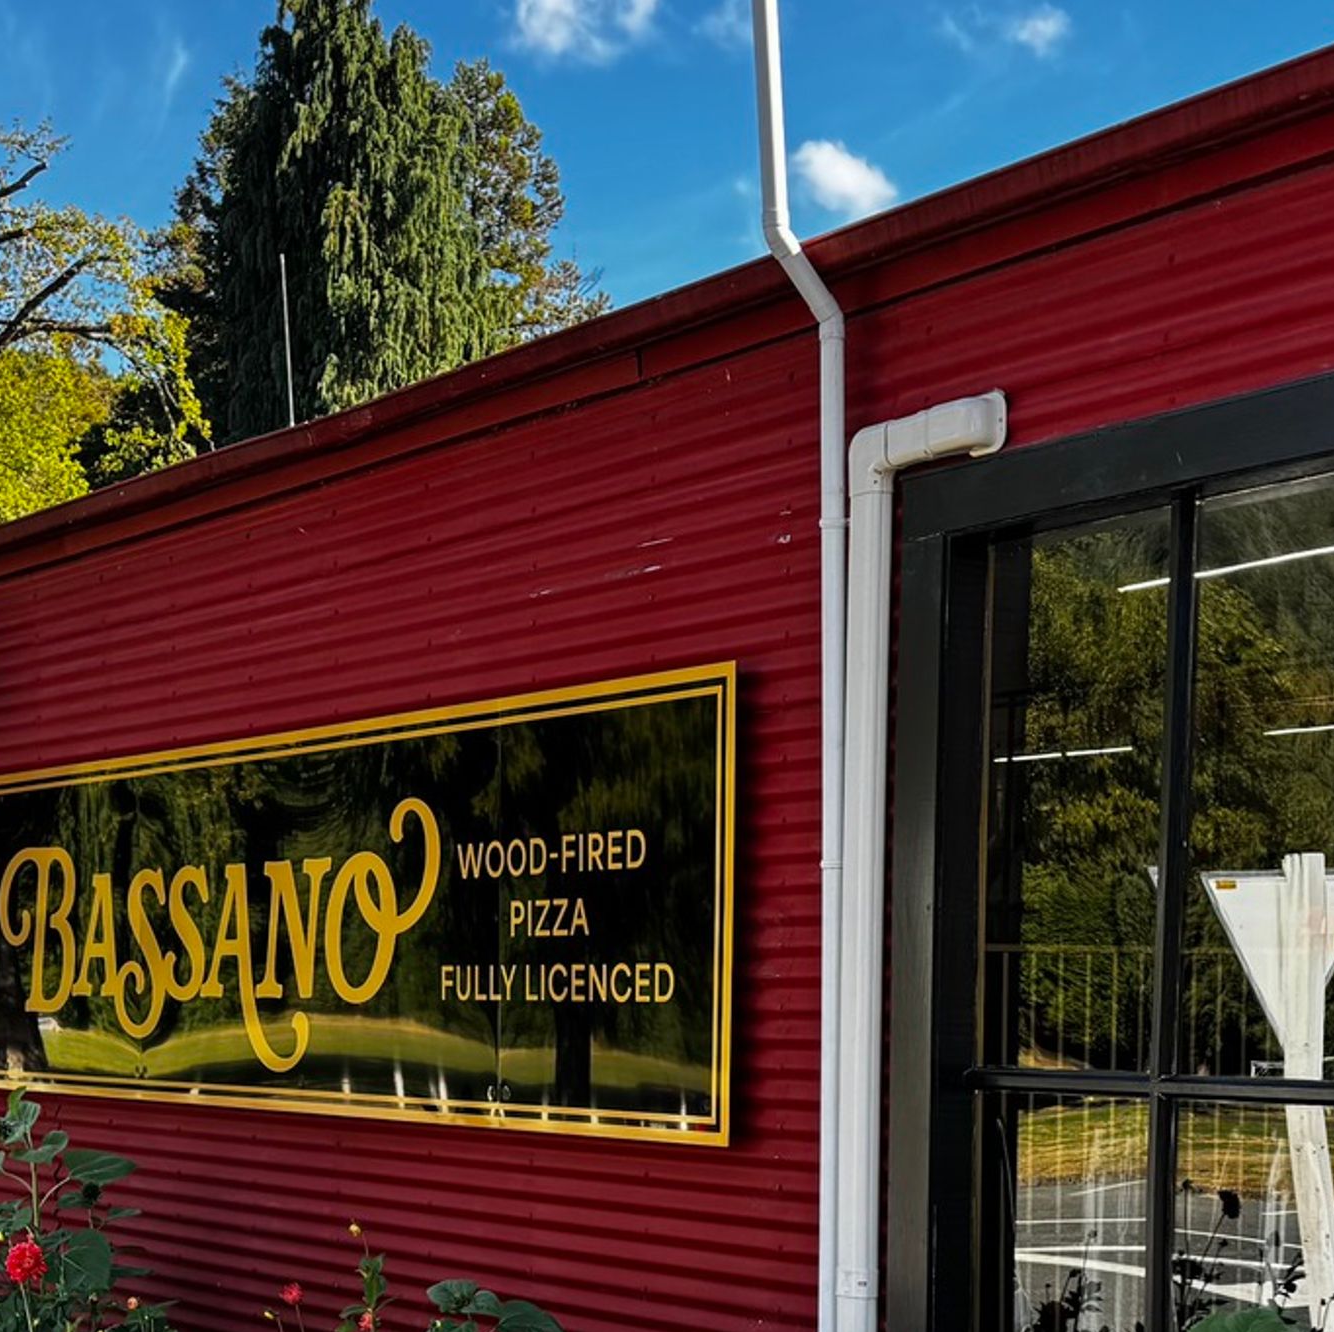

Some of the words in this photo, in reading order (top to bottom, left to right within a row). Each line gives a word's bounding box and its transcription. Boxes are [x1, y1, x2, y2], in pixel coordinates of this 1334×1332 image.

[458, 829, 647, 880] WOOD-FIRED
[510, 898, 590, 937] PIZZA
[441, 964, 517, 1001] FULLY
[525, 962, 675, 1003] LICENCED
